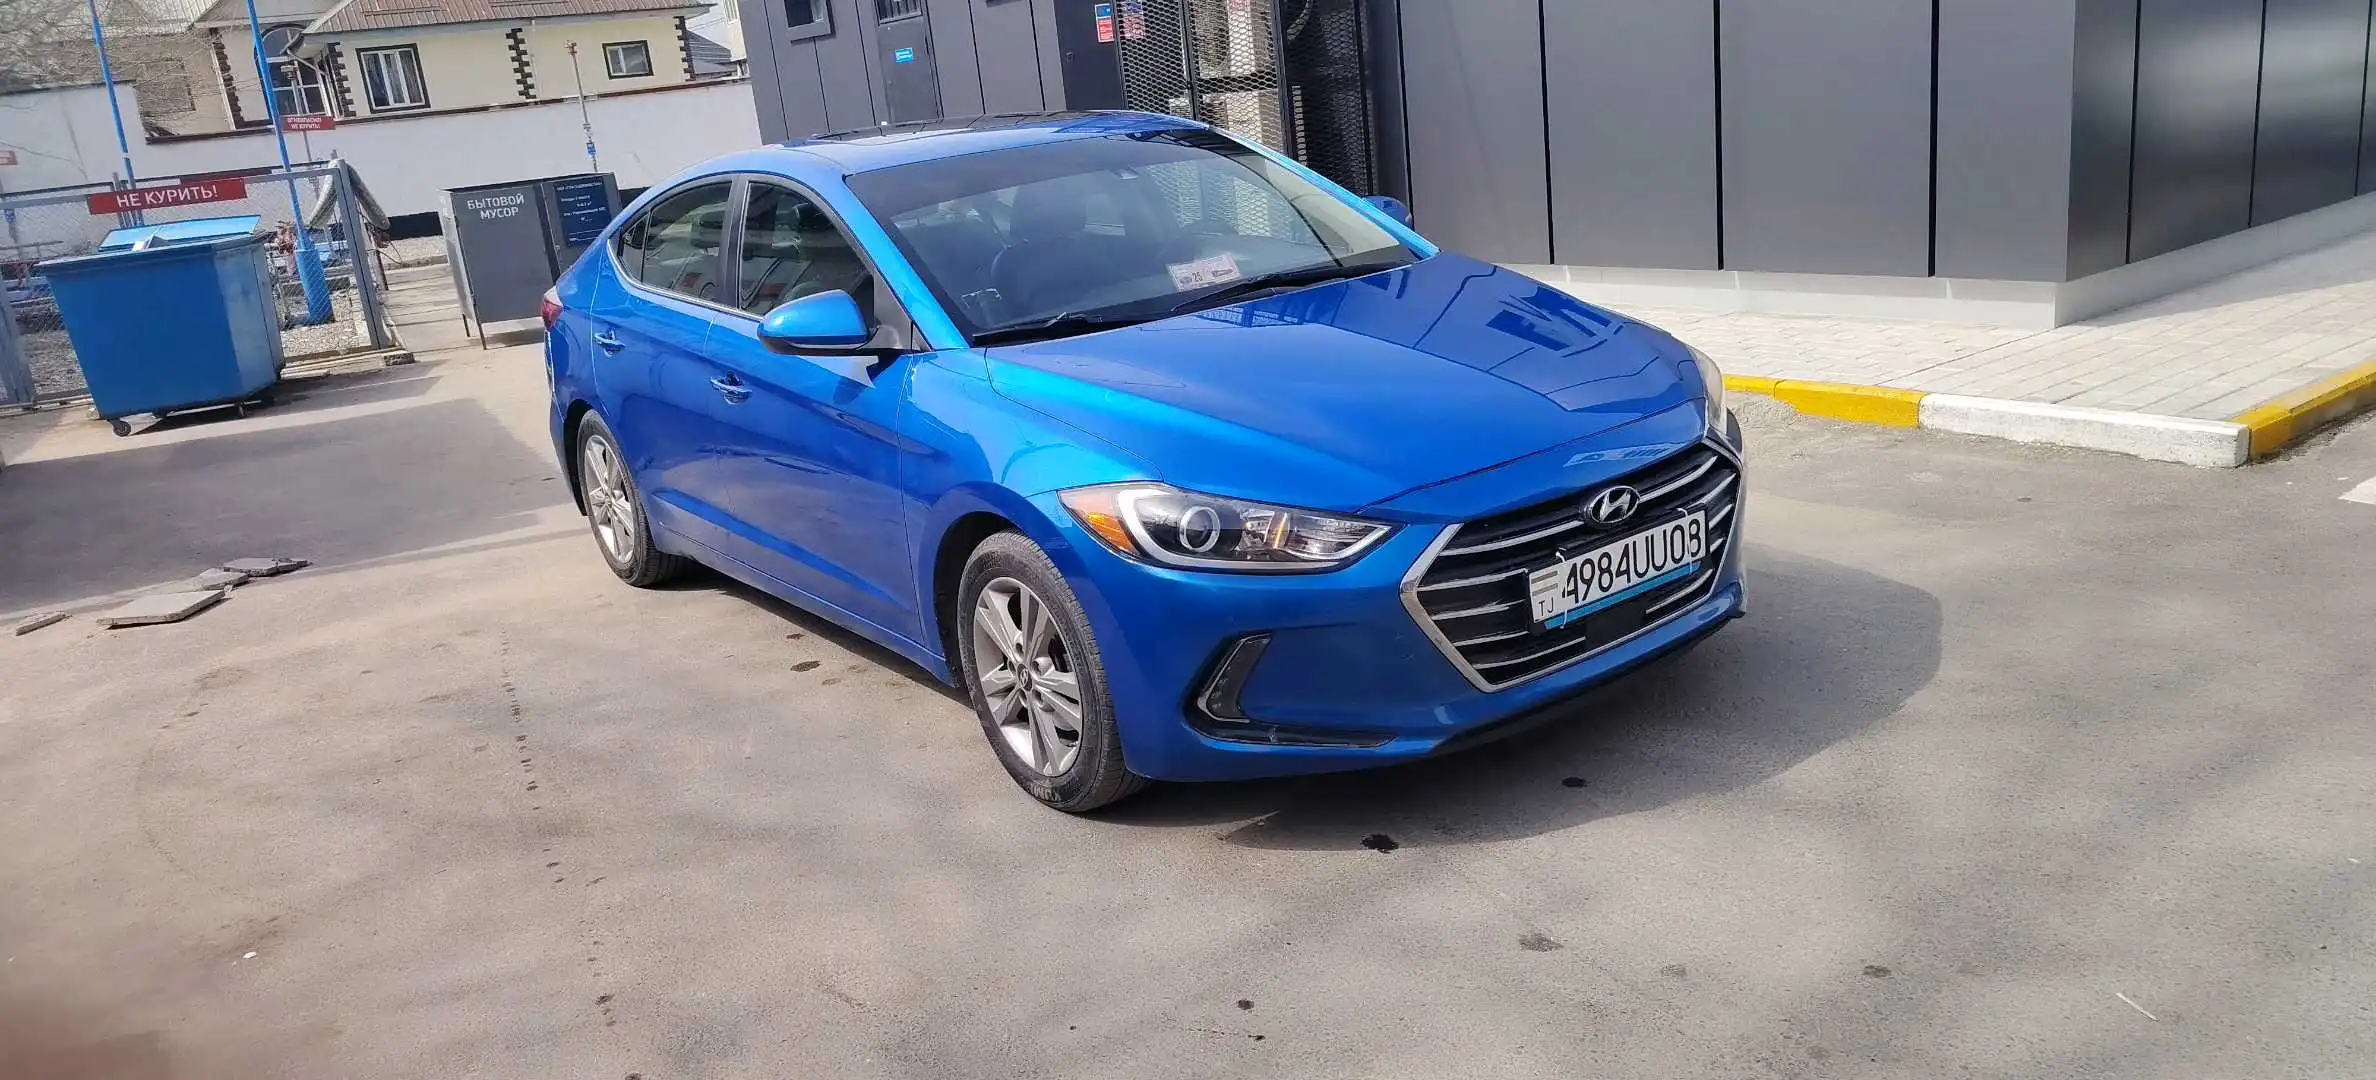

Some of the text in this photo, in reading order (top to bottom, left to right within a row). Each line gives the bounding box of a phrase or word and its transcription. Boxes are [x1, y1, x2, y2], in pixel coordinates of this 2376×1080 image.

[116, 184, 219, 208] НЕ КУРИТЬ!
[466, 192, 525, 210] БЫТОВОЙ
[480, 206, 520, 220] МУСОР
[1538, 596, 1554, 616] TJ
